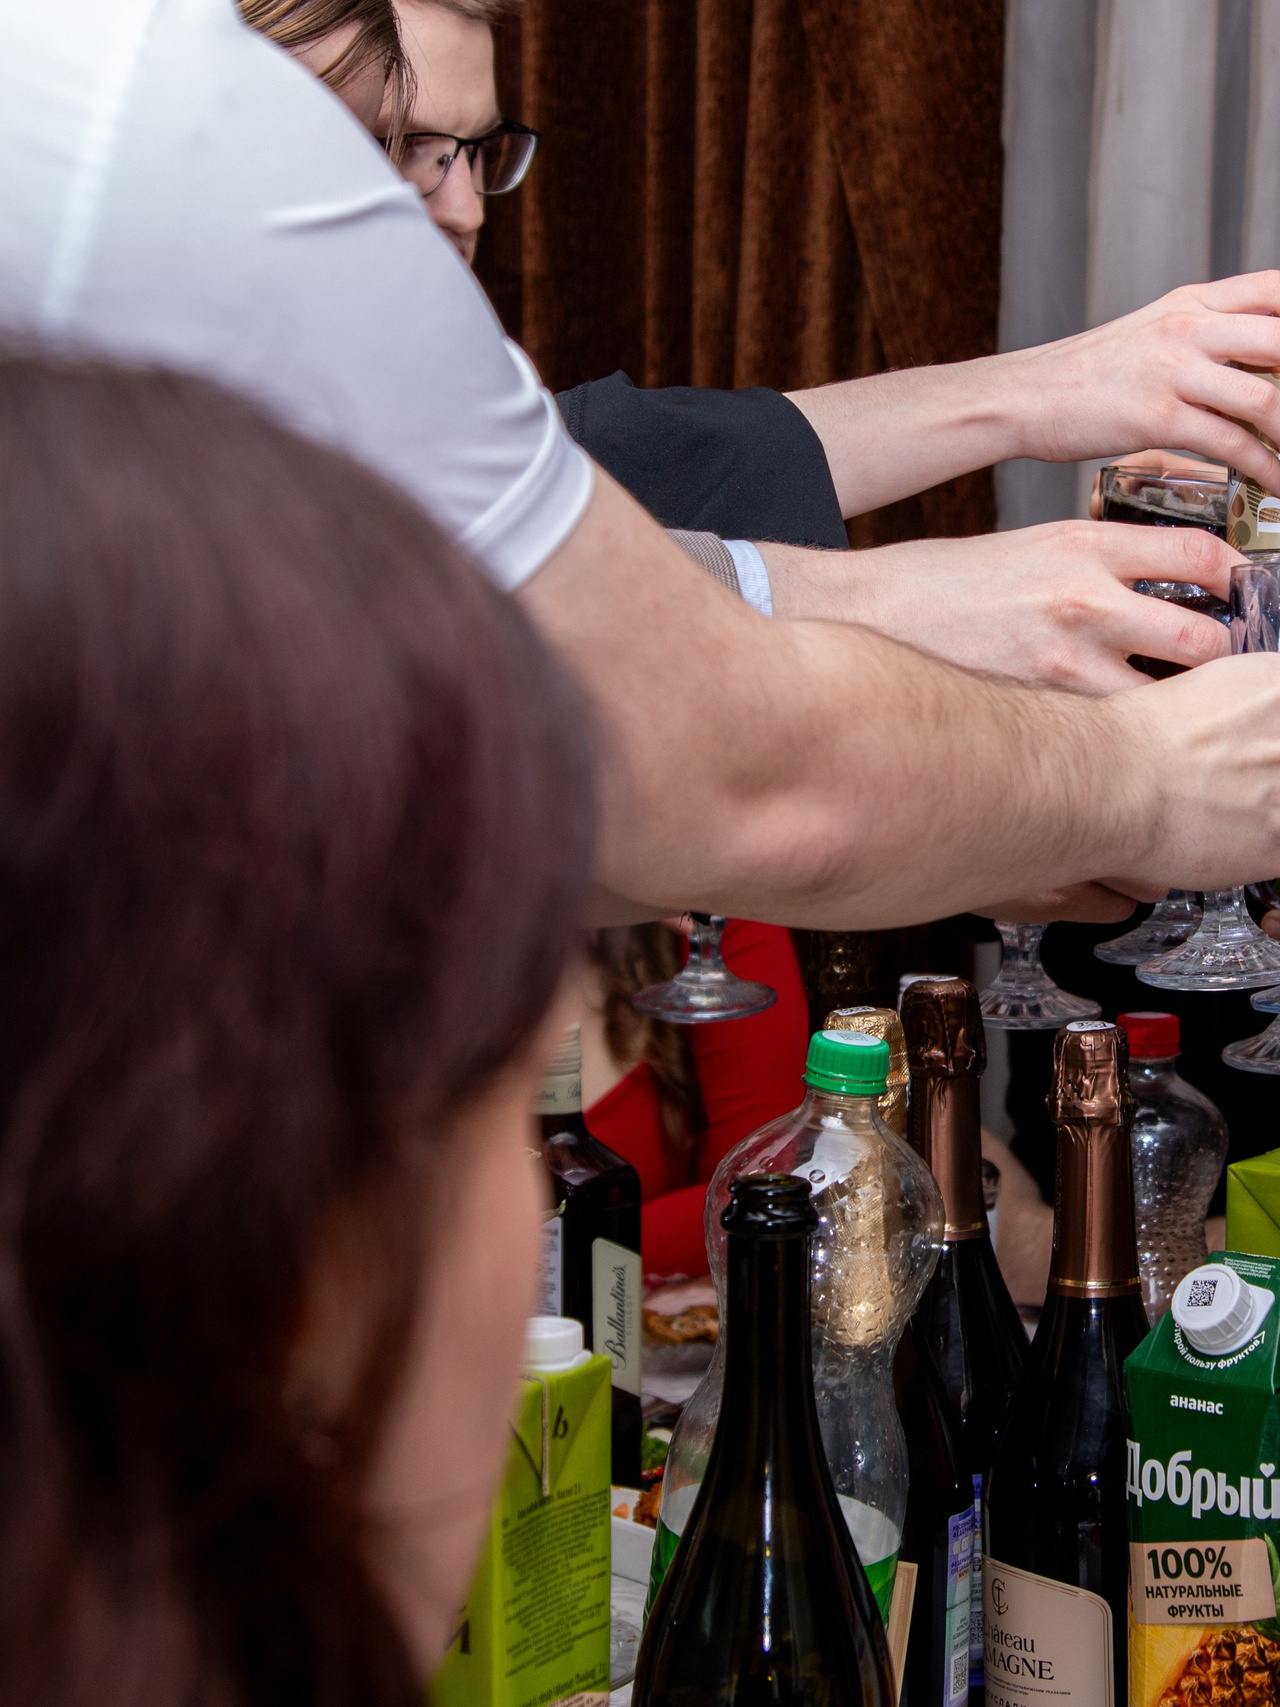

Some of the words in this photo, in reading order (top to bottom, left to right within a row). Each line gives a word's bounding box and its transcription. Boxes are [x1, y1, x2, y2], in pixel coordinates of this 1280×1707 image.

[604, 1264, 626, 1370] Ballantine's
[1184, 1353, 1217, 1370] пользу
[1217, 1339, 1260, 1369] фруктов
[1170, 1394, 1224, 1415] ананас
[1146, 1546, 1232, 1580] 100%
[1145, 1582, 1244, 1601] НАТУРАЛЬНЫЕ
[1167, 1602, 1225, 1619] ФРУКТЫ
